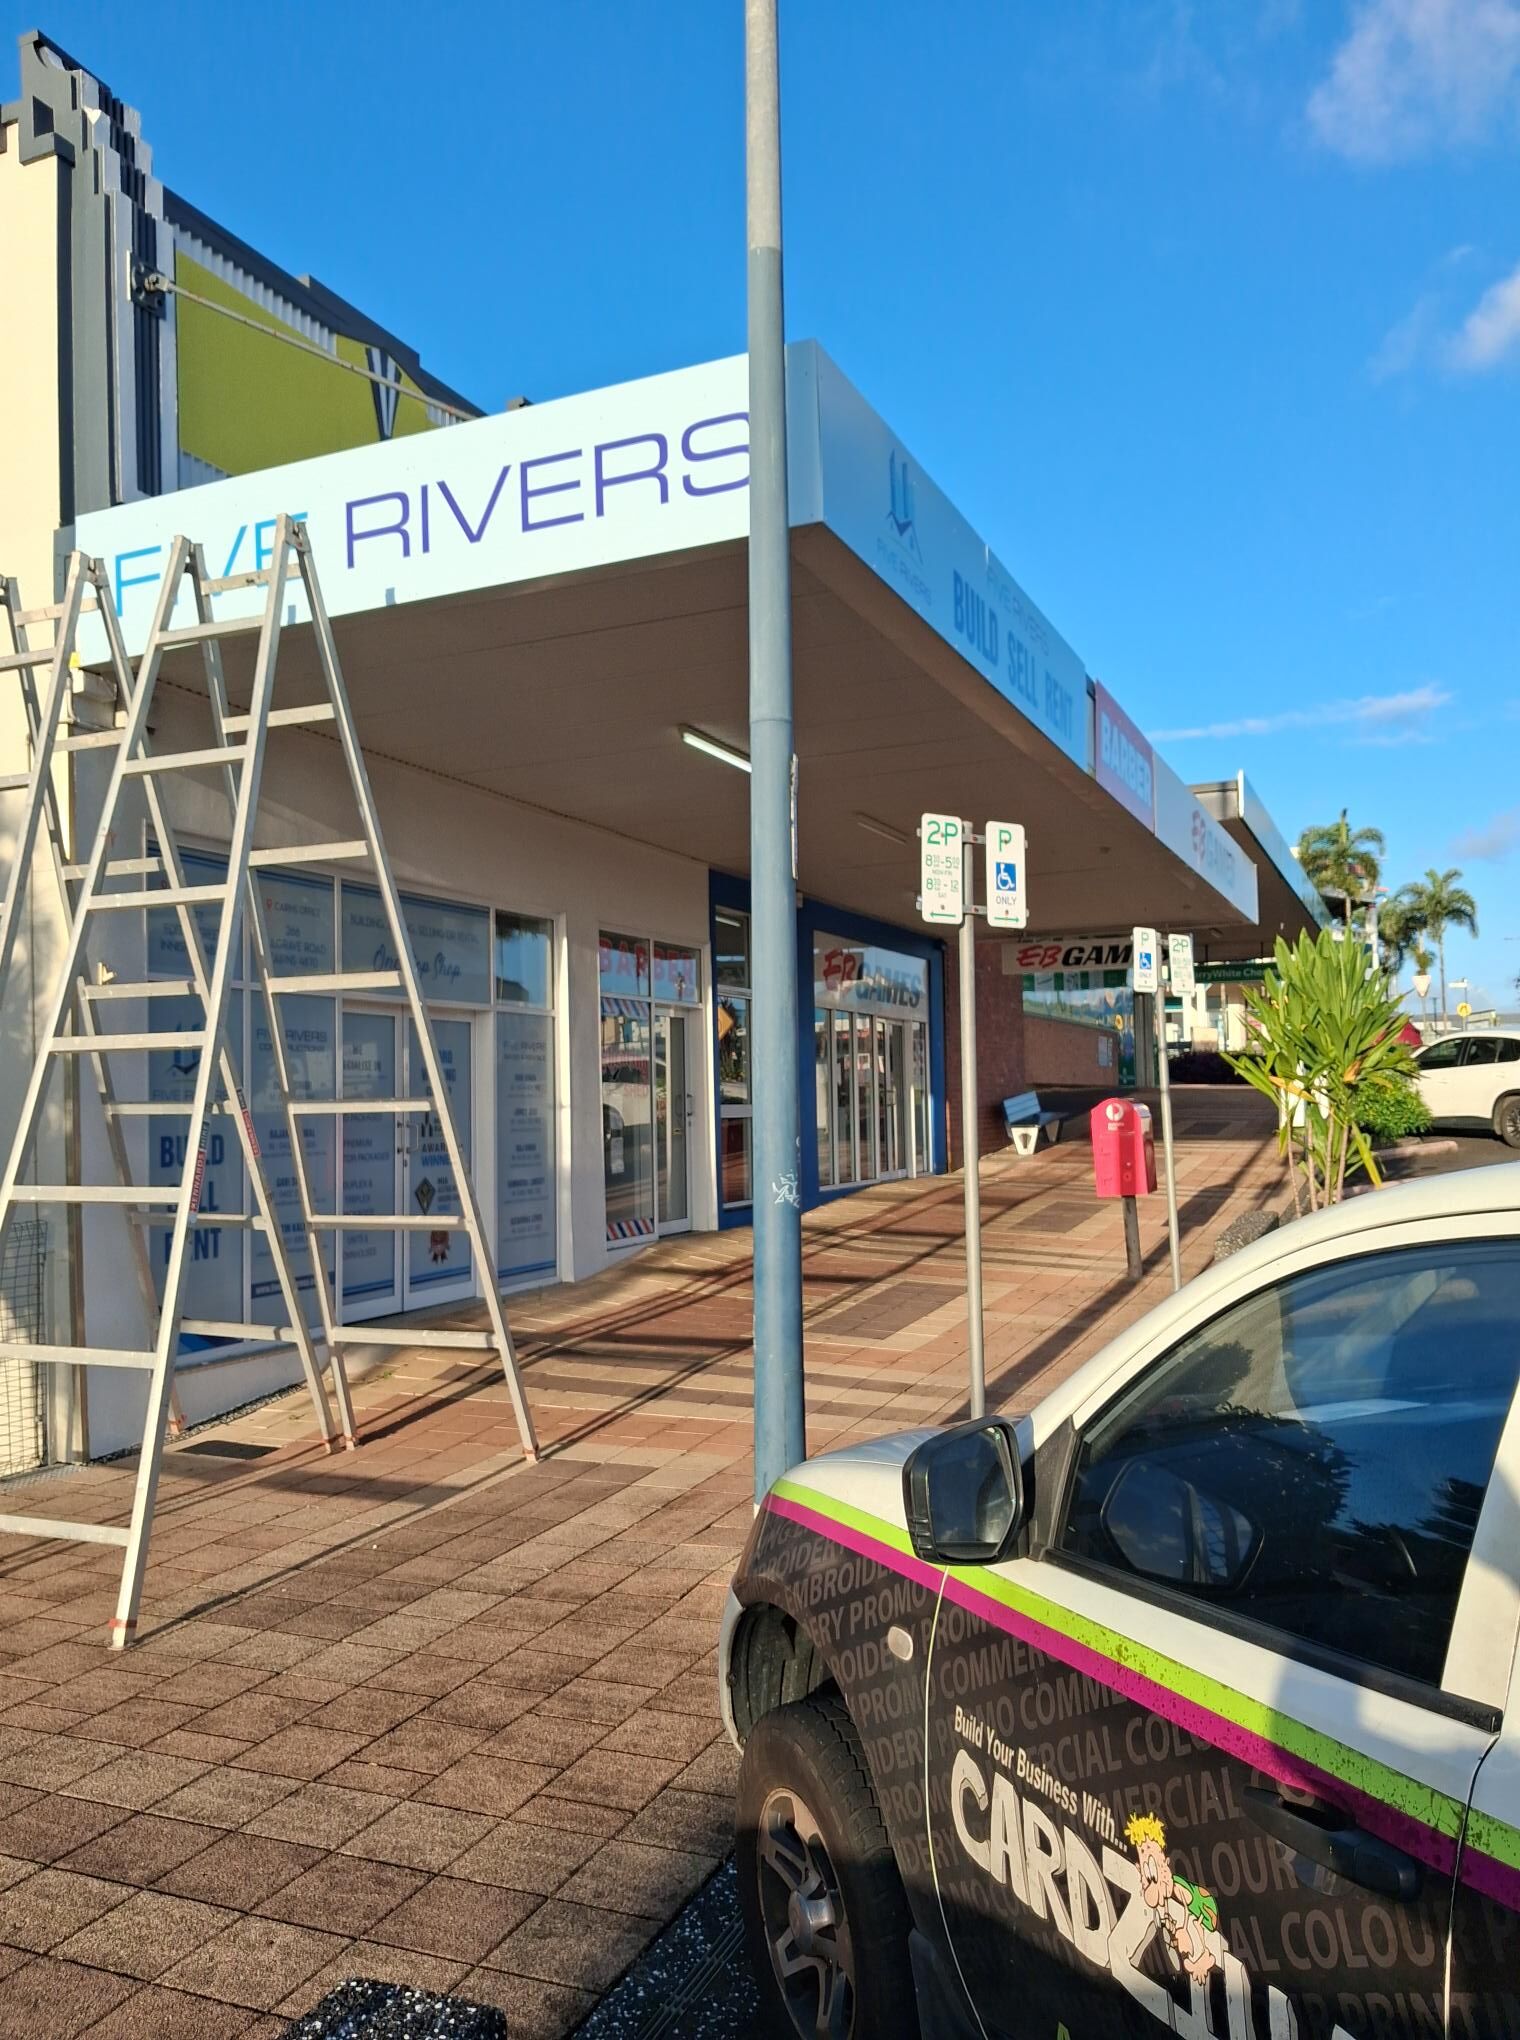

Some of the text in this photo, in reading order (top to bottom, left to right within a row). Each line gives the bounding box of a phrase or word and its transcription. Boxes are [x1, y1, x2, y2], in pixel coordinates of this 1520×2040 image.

[345, 411, 749, 569] RIVERS
[953, 568, 1073, 742] BUILD SELL RENT
[927, 820, 958, 846] 2P
[998, 829, 1012, 852] P
[995, 896, 1017, 905] ONLY
[1061, 944, 1135, 966] GAM
[858, 1670, 937, 1729] PROMO
[955, 1704, 982, 1749] Build
[986, 1725, 1014, 1769] Your
[1017, 1746, 1078, 1816] Business
